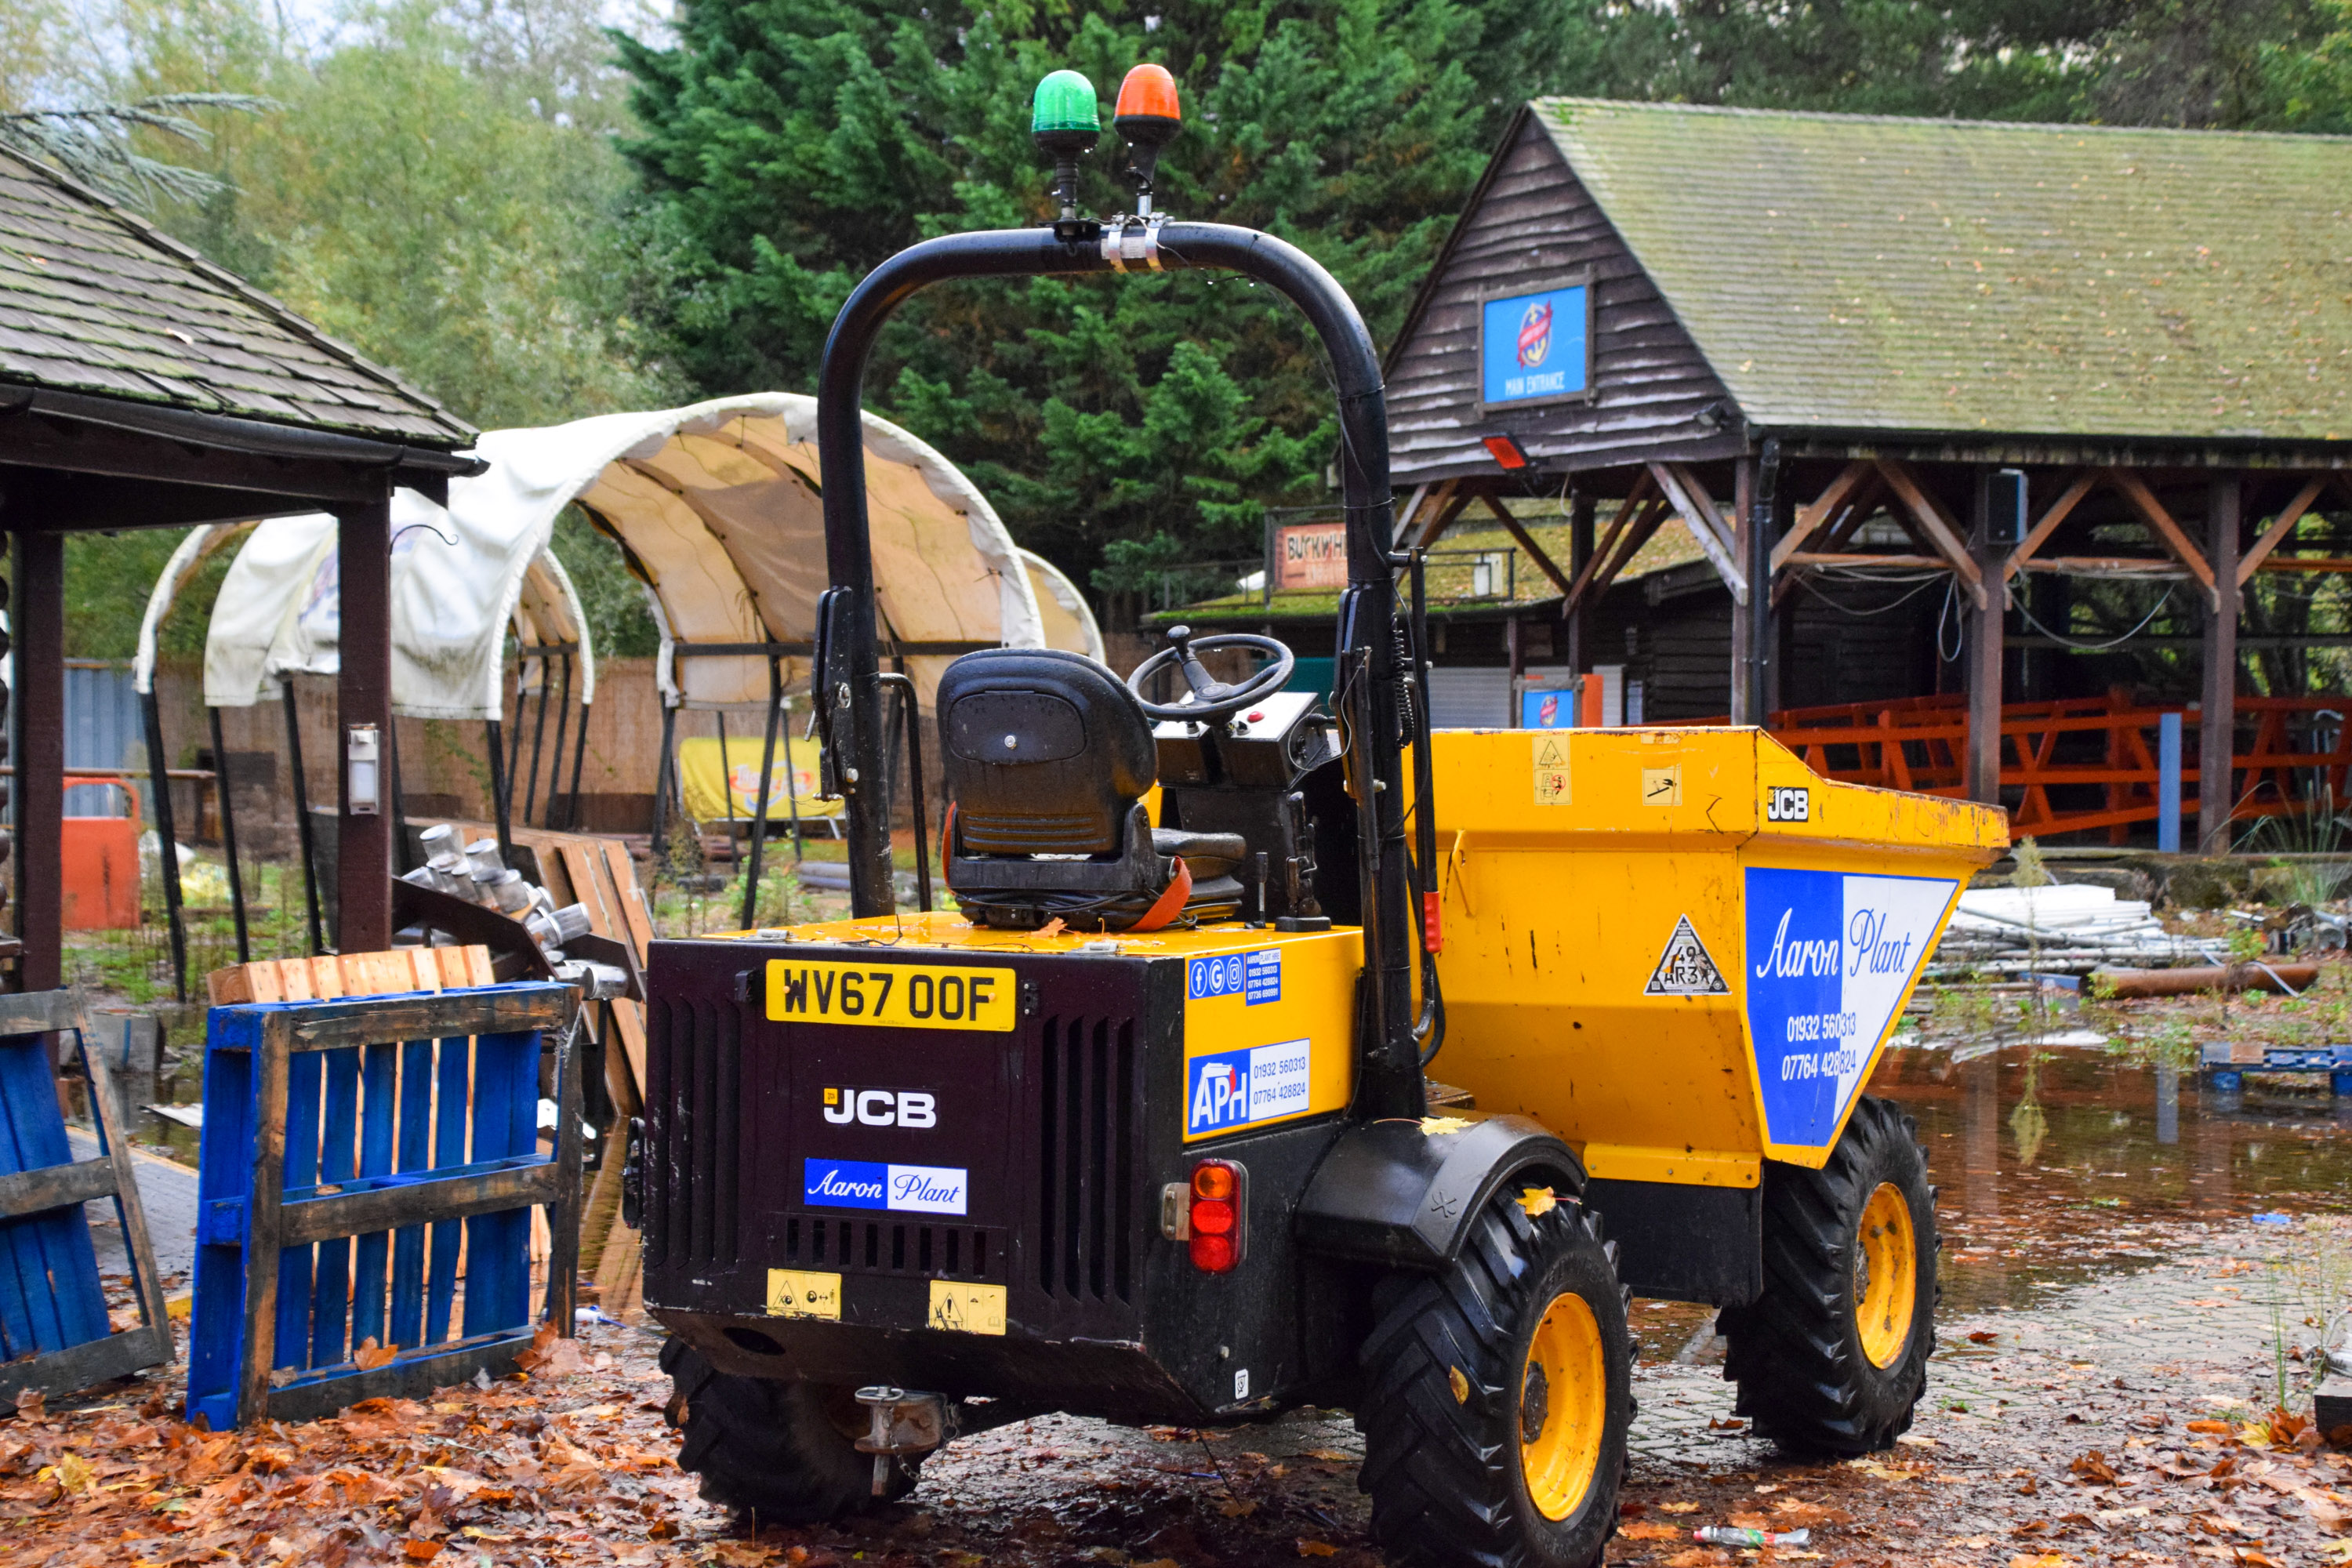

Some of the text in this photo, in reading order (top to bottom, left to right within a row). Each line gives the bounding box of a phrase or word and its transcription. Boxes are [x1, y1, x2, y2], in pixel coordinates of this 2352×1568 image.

[1505, 370, 1565, 396] MAIN ENTRANCE
[1287, 532, 1348, 561] BUCKWH
[1768, 789, 1809, 820] JCB
[1756, 907, 1911, 979] Aaron Plant
[784, 969, 995, 1022] WV67 OOF
[1787, 1011, 1857, 1042] 01932 560313
[1254, 1056, 1305, 1080] 01932 560313
[1781, 1051, 1857, 1081] 07764 428824
[823, 1088, 937, 1129] JCB
[1254, 1082, 1305, 1105] 07764 428824
[808, 1169, 960, 1203] Aaron Plant
